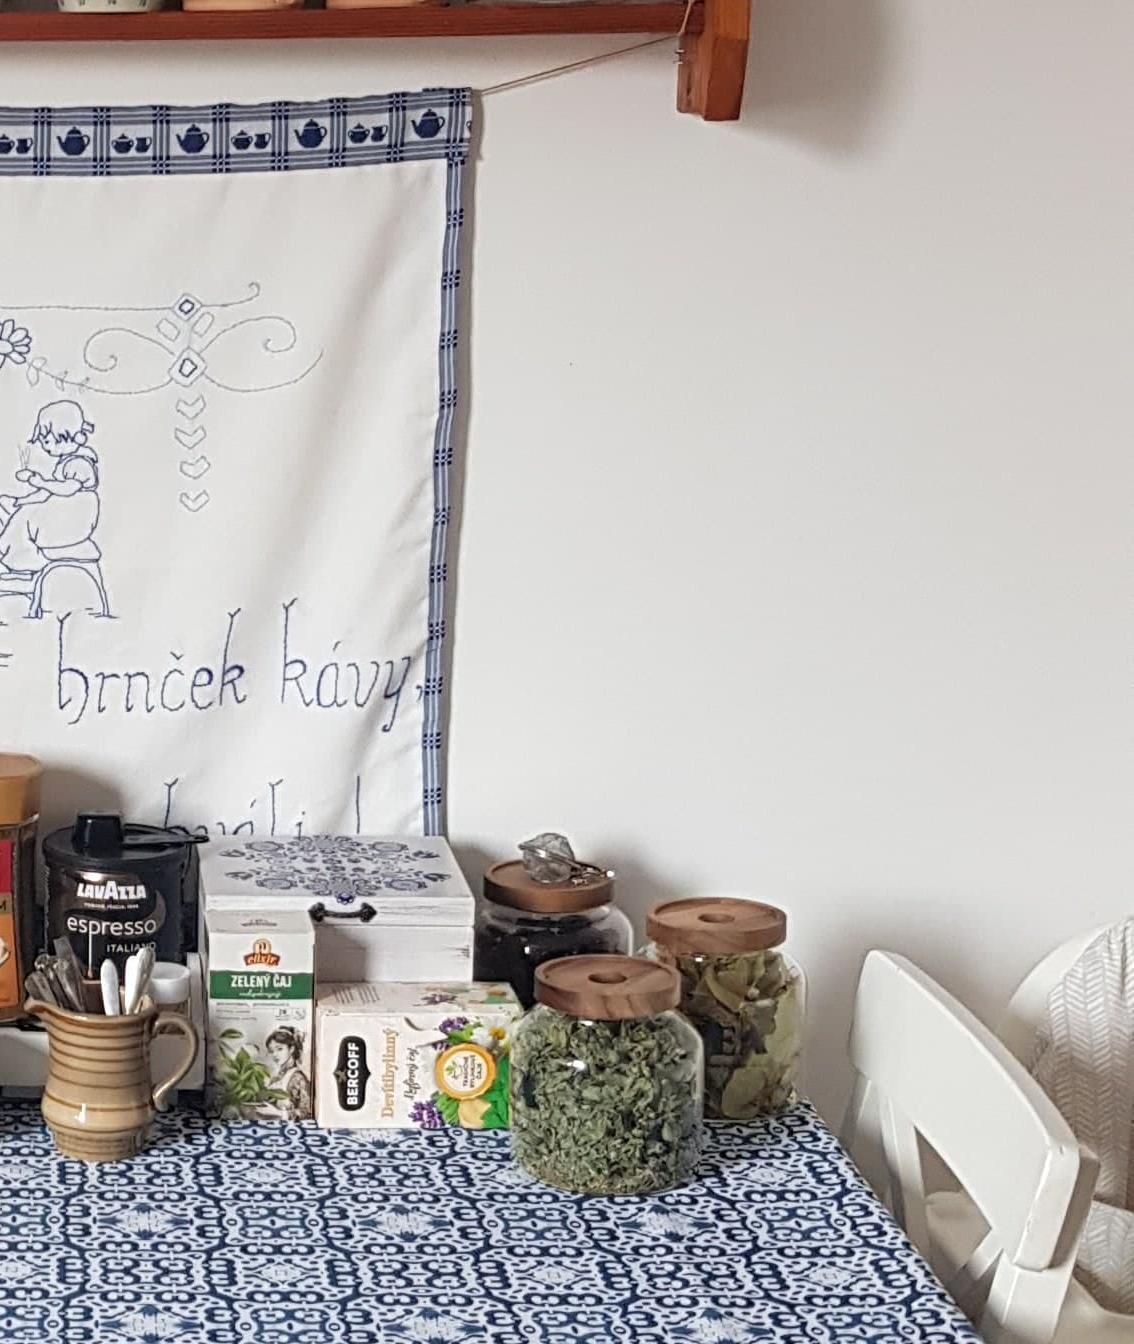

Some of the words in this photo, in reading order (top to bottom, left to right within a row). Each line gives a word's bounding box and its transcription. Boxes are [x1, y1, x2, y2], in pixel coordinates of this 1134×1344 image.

[76, 880, 147, 900] LAVAZZA
[66, 915, 157, 937] espresso
[230, 973, 271, 989] ZELENÝ
[272, 973, 293, 988] ČAJ
[346, 1041, 360, 1106] BERCOFF
